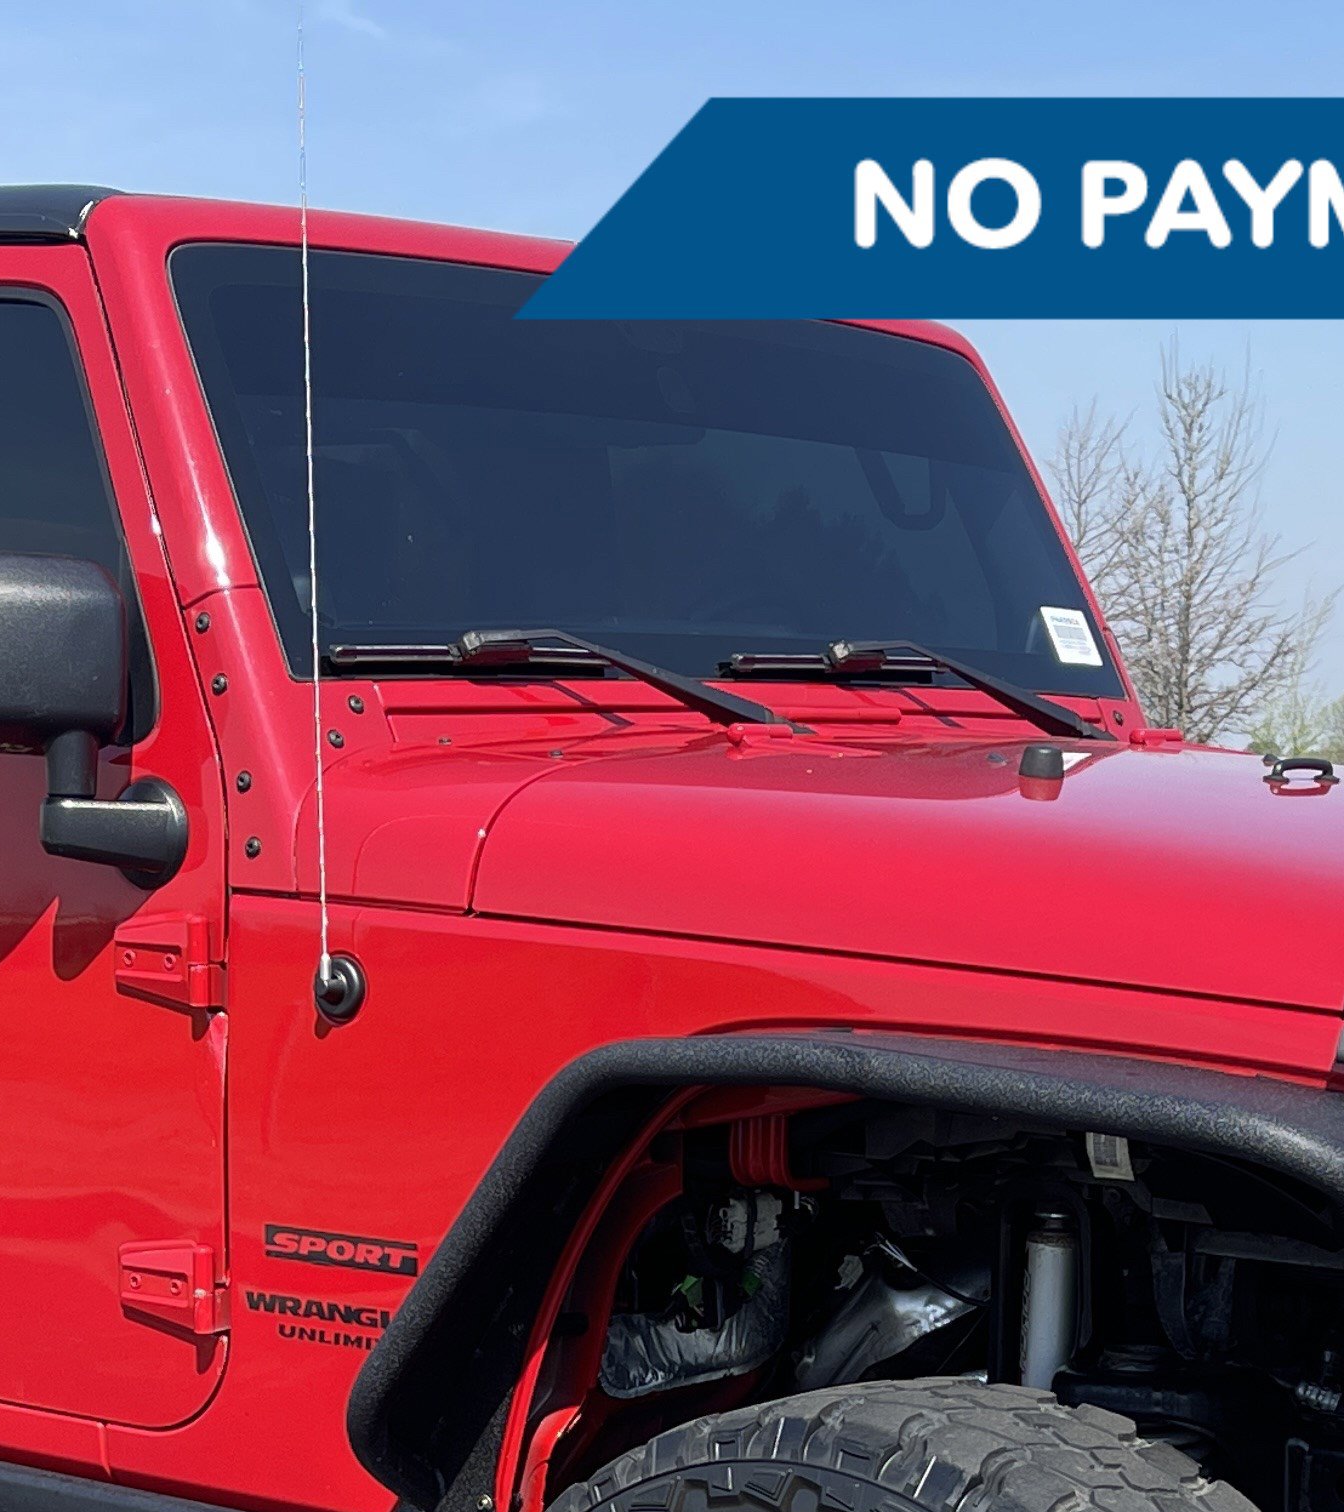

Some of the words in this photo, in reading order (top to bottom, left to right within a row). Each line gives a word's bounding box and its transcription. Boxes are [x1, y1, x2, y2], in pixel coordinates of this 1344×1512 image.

[266, 1231, 417, 1269] SPORT
[246, 1291, 391, 1329] WRANGL
[278, 1323, 379, 1350] UNLIMI
